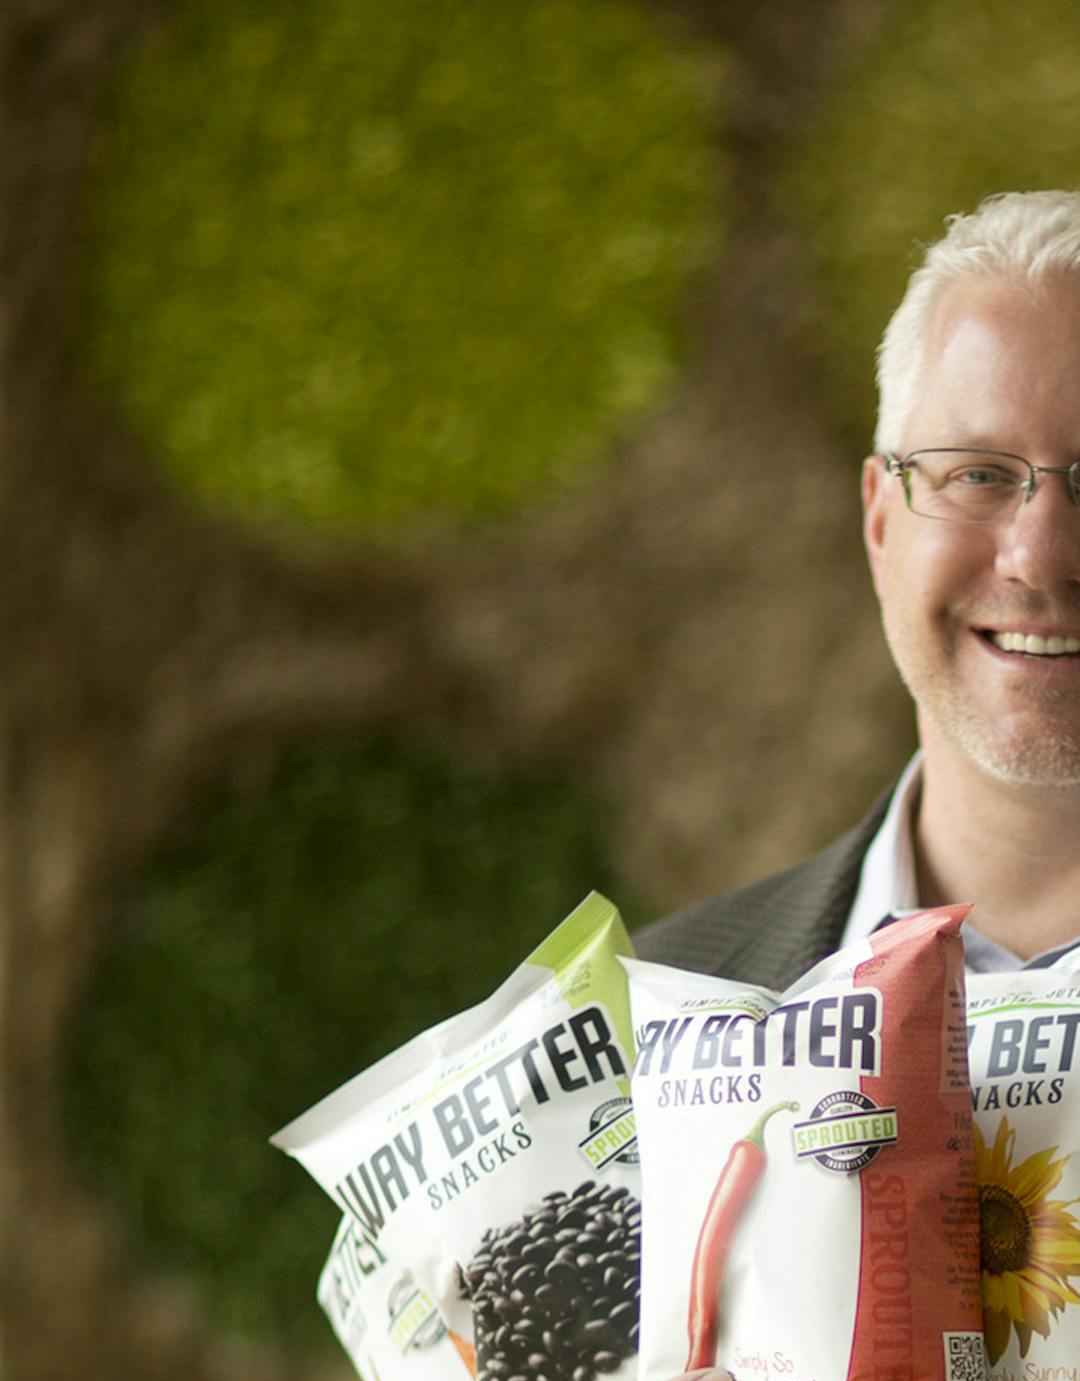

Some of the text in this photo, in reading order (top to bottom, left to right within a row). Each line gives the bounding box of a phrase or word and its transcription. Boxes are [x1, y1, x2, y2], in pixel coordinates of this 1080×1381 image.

[968, 996, 1007, 1009] MPLY
[692, 993, 879, 1070] BETTER
[657, 1073, 761, 1108] SNACKS
[971, 1078, 1064, 1112] NACKS
[336, 1120, 427, 1239] WAY
[433, 1006, 626, 1158] BETTER
[796, 1116, 894, 1151] SPROUTED
[427, 1122, 533, 1211] SNACKS
[772, 1351, 795, 1374] So
